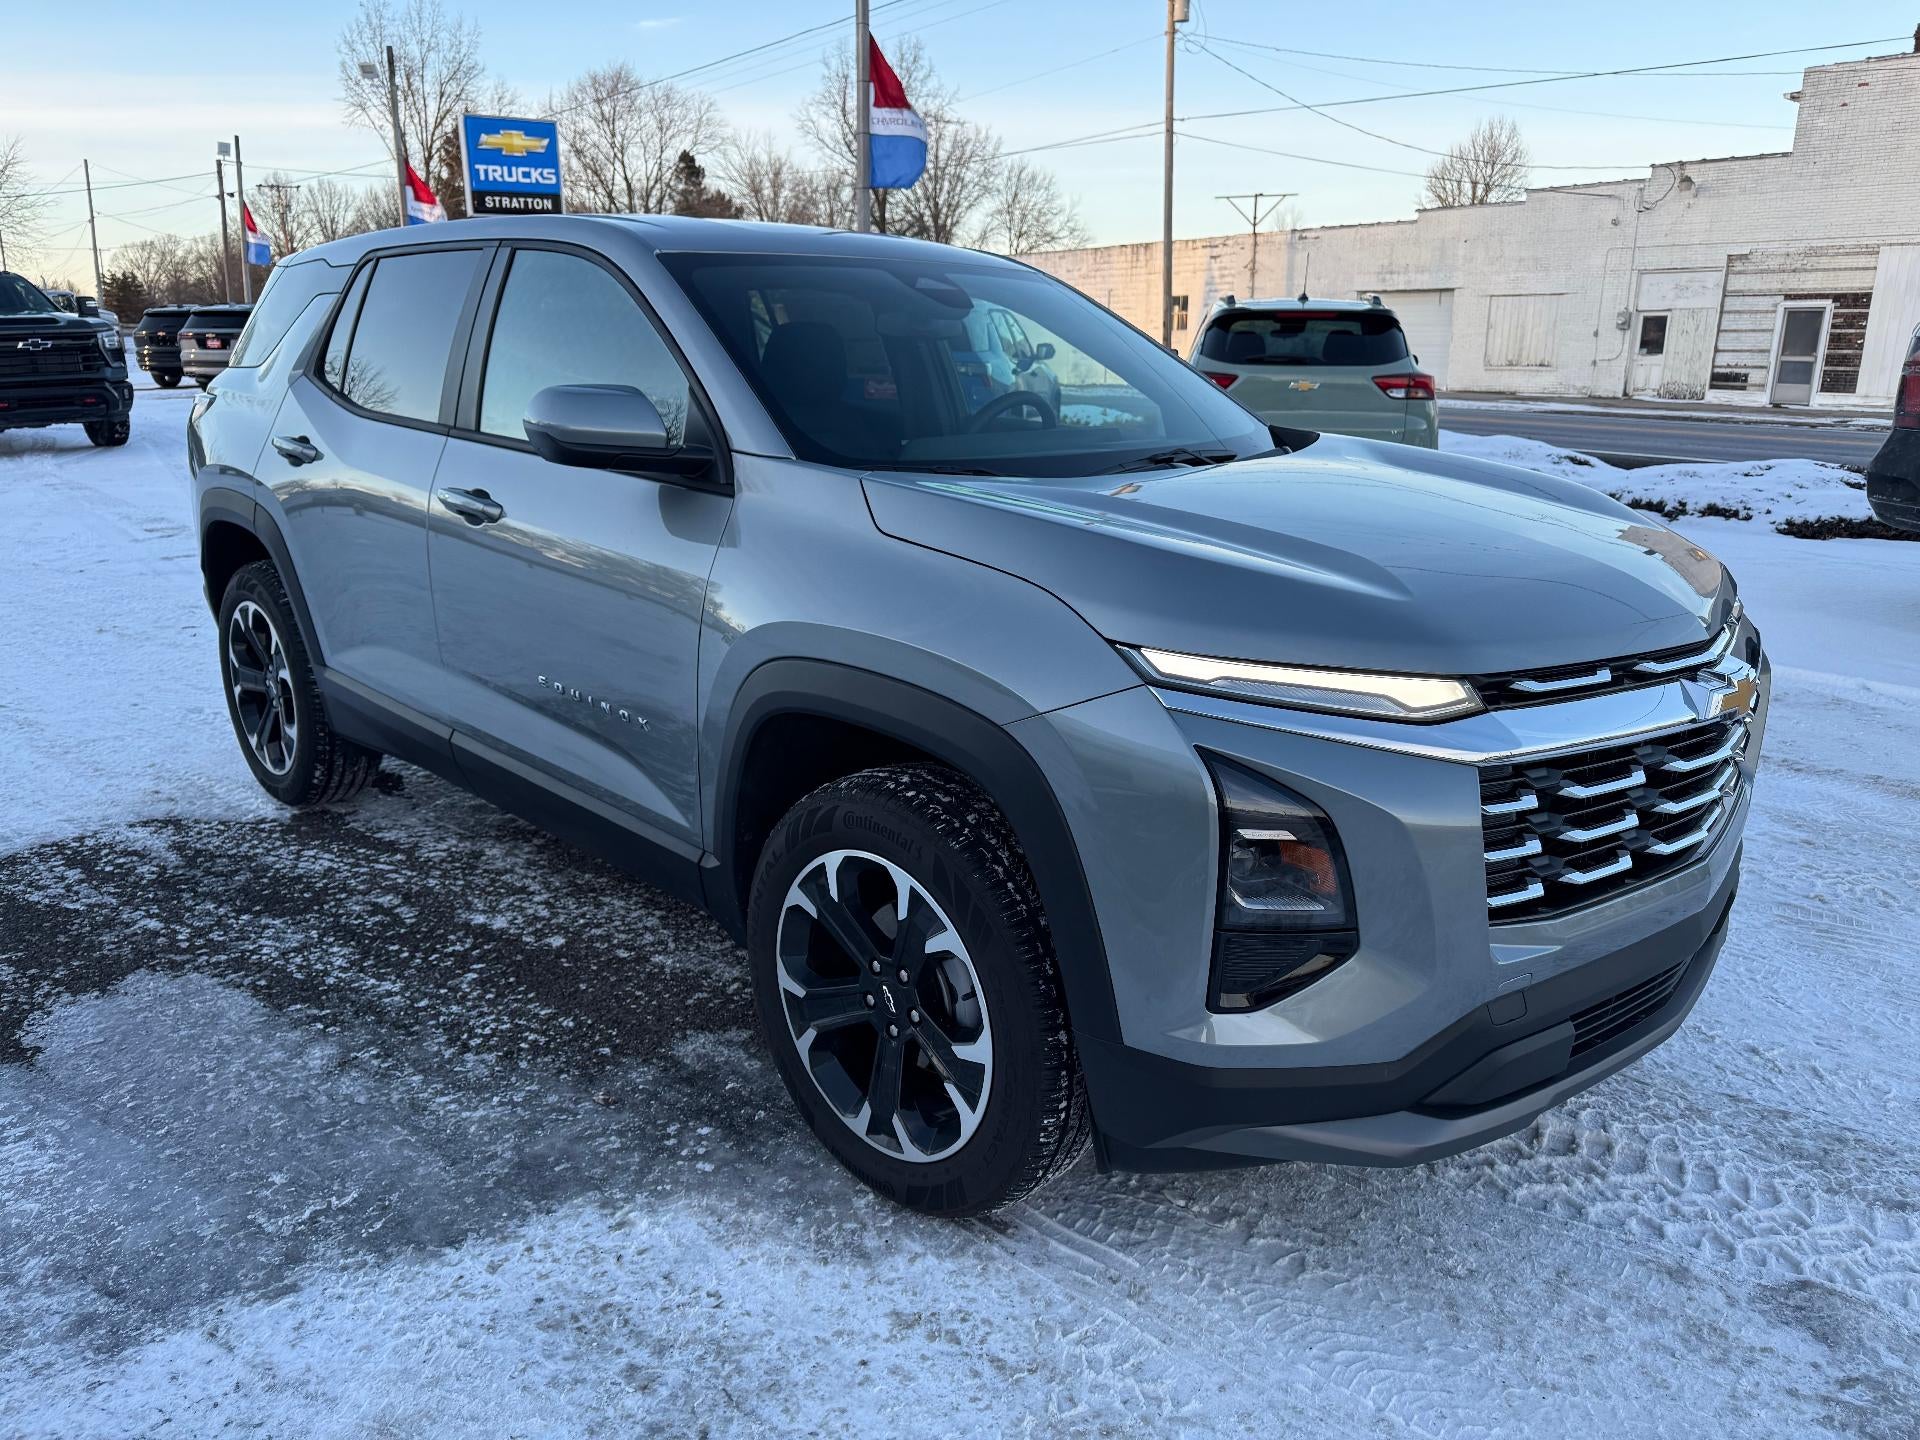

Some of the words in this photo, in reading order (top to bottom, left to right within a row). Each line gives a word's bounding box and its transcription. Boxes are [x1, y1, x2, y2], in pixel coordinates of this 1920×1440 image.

[474, 164, 557, 185] TRUCKS
[484, 196, 552, 210] STRATTON
[537, 675, 650, 731] EQUINOX
[843, 810, 914, 854] Continental
